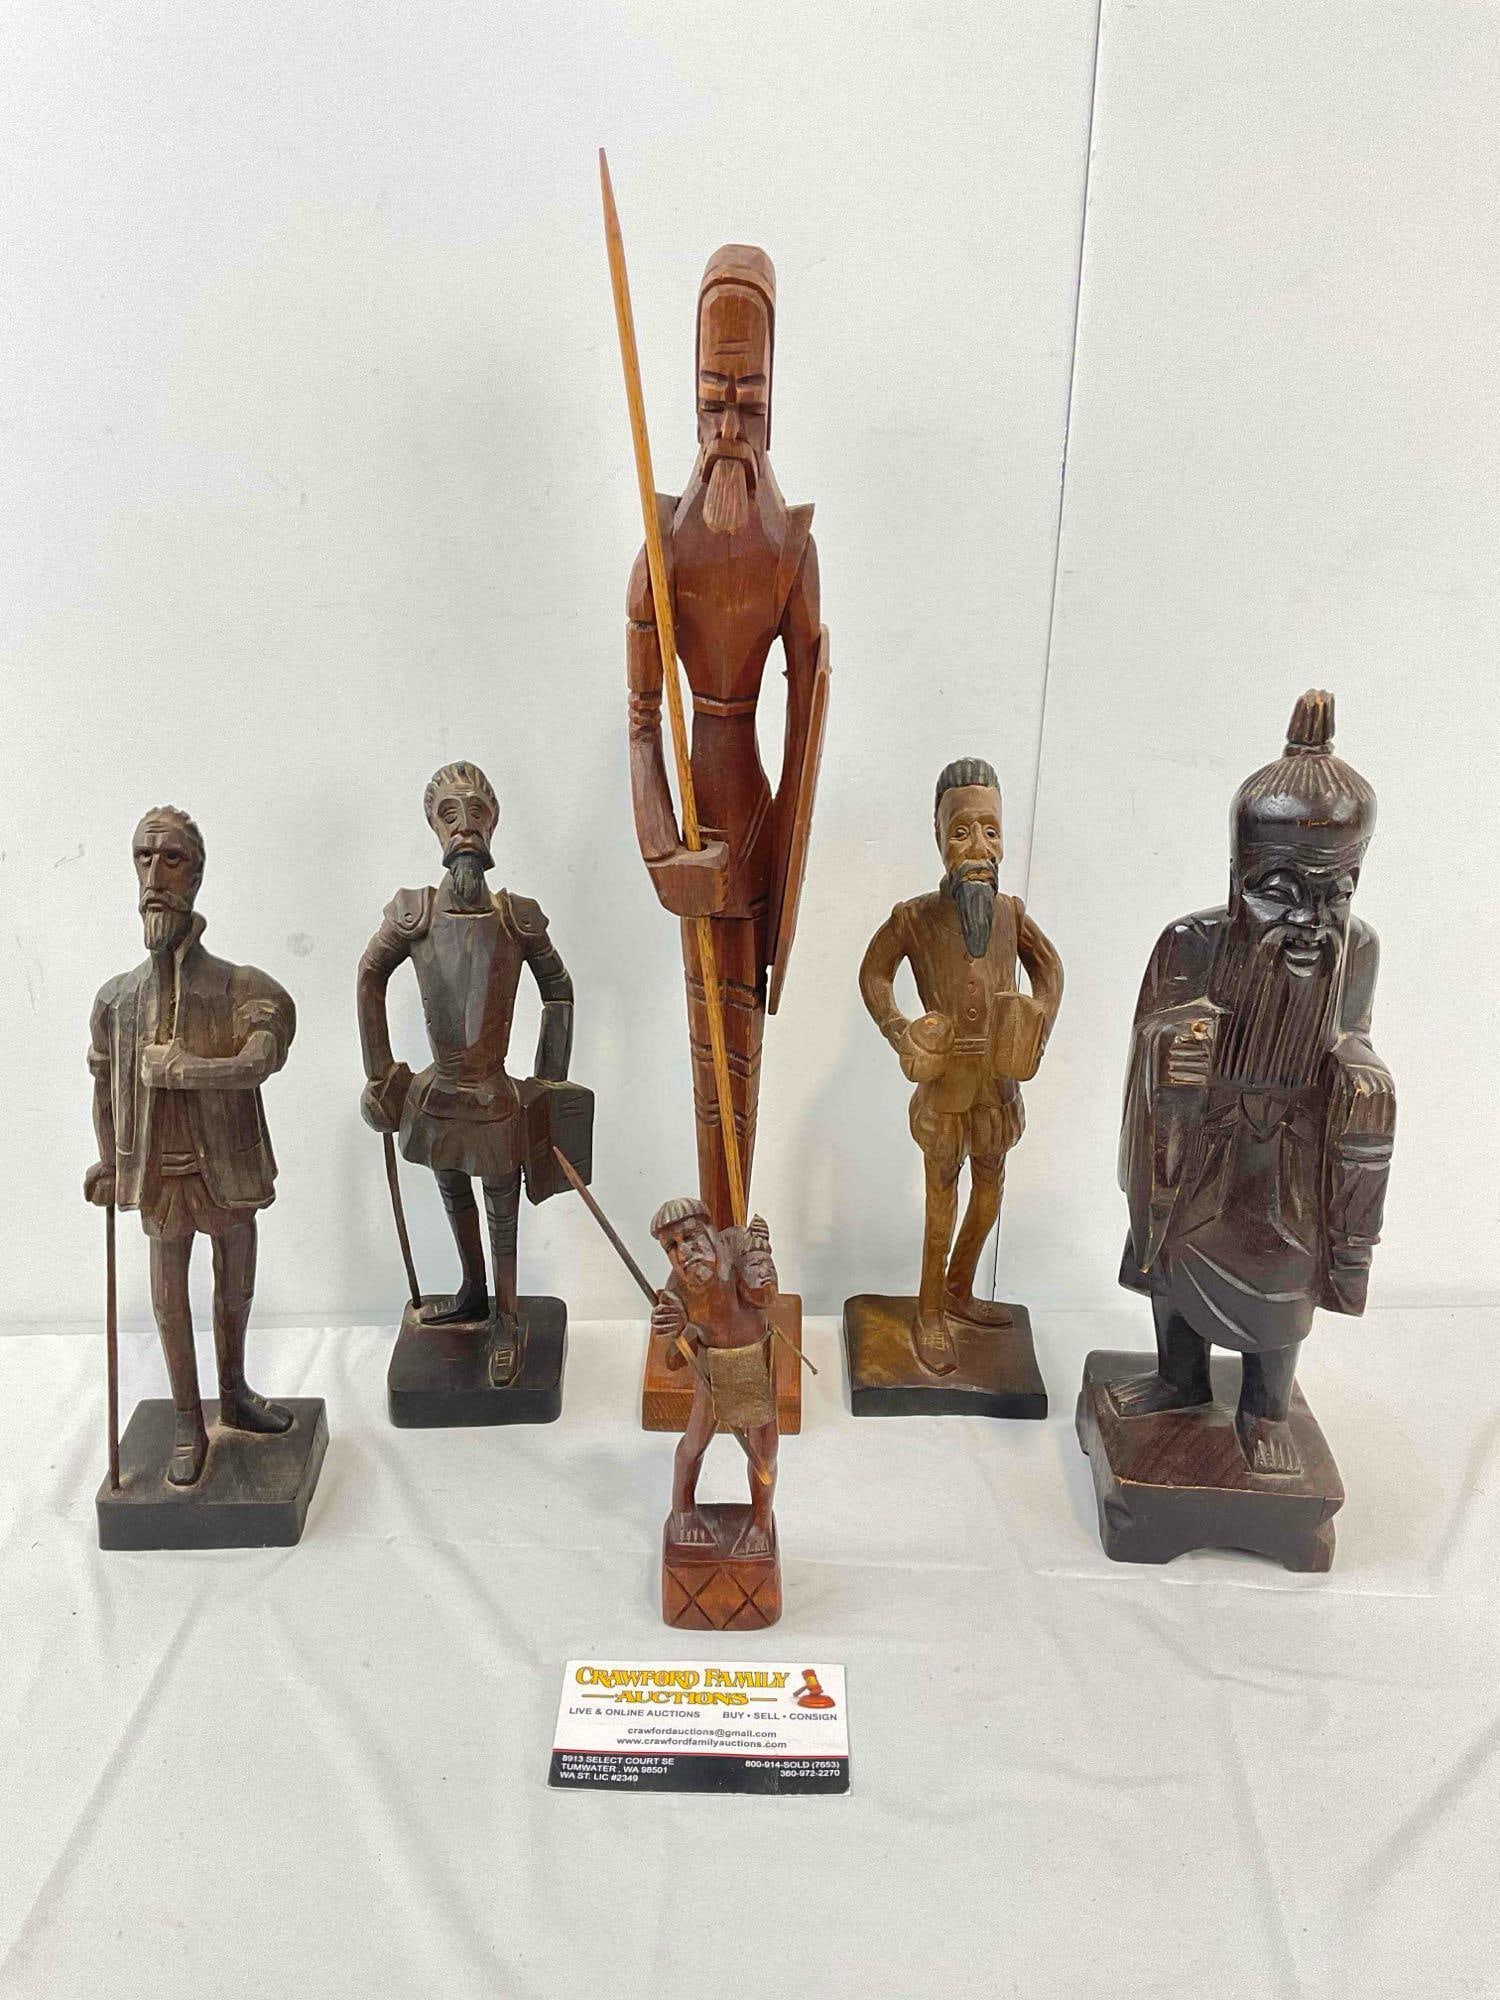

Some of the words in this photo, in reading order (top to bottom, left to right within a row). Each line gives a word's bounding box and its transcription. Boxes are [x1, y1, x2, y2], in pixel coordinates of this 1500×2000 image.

[576, 1666, 700, 1689] CRAWFORD
[704, 1668, 790, 1688] FAMILY
[614, 1690, 749, 1706] AUCTIONS
[568, 1707, 593, 1715] LIVE
[605, 1708, 645, 1717] ONLINE
[646, 1709, 701, 1719] AUCTIONS
[722, 1711, 745, 1719] BUY
[753, 1712, 781, 1720] SELL
[789, 1712, 838, 1721] CONSIGN
[627, 1727, 777, 1738] crawfordauctions@gmail.com
[617, 1737, 787, 1748] www.crawfordfamilyauctions.com
[585, 1756, 623, 1764] SELECT
[625, 1757, 659, 1765] COURT
[745, 1760, 810, 1769] 800-914-SOLD
[561, 1763, 616, 1772] TUMWATER
[780, 1769, 840, 1777] 360-972-2270
[560, 1771, 576, 1779] WA
[593, 1773, 609, 1781] LIC
[611, 1773, 639, 1782] #2349
